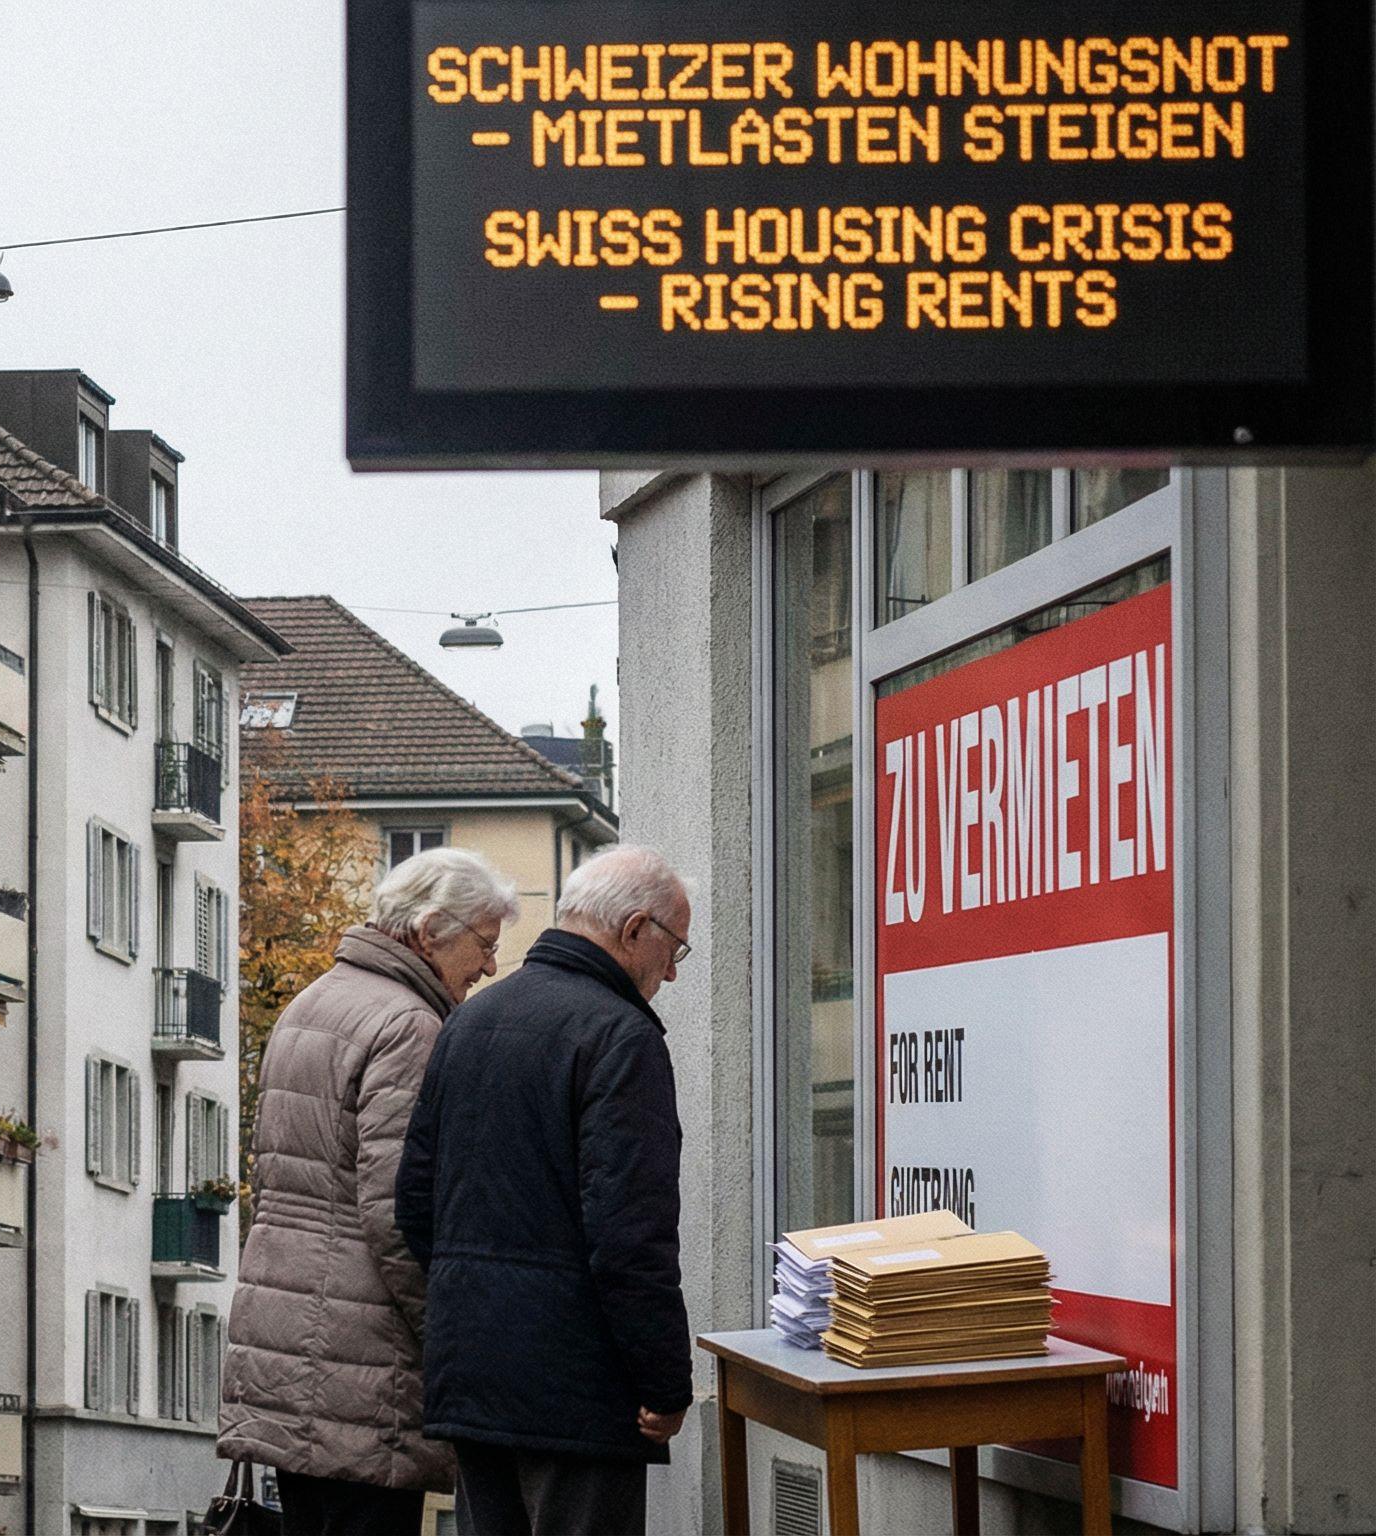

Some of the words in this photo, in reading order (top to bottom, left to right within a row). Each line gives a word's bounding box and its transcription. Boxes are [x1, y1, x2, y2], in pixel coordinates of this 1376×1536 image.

[428, 42, 793, 103] SCHWEIZER
[817, 36, 1288, 98] WOHNUNGSNOT
[532, 105, 941, 168] MIETLASTEN
[964, 102, 1244, 161] STEIGEN
[485, 209, 682, 267] SWISS
[705, 205, 986, 264] HOUSING
[1010, 203, 1232, 262] CRISIS
[661, 273, 883, 331] RISING
[907, 270, 1116, 329] RENTS
[885, 731, 926, 926] ZU
[935, 643, 1166, 914] VERMIETEN
[890, 1032, 919, 1104] FOR
[924, 1028, 965, 1102] RENT
